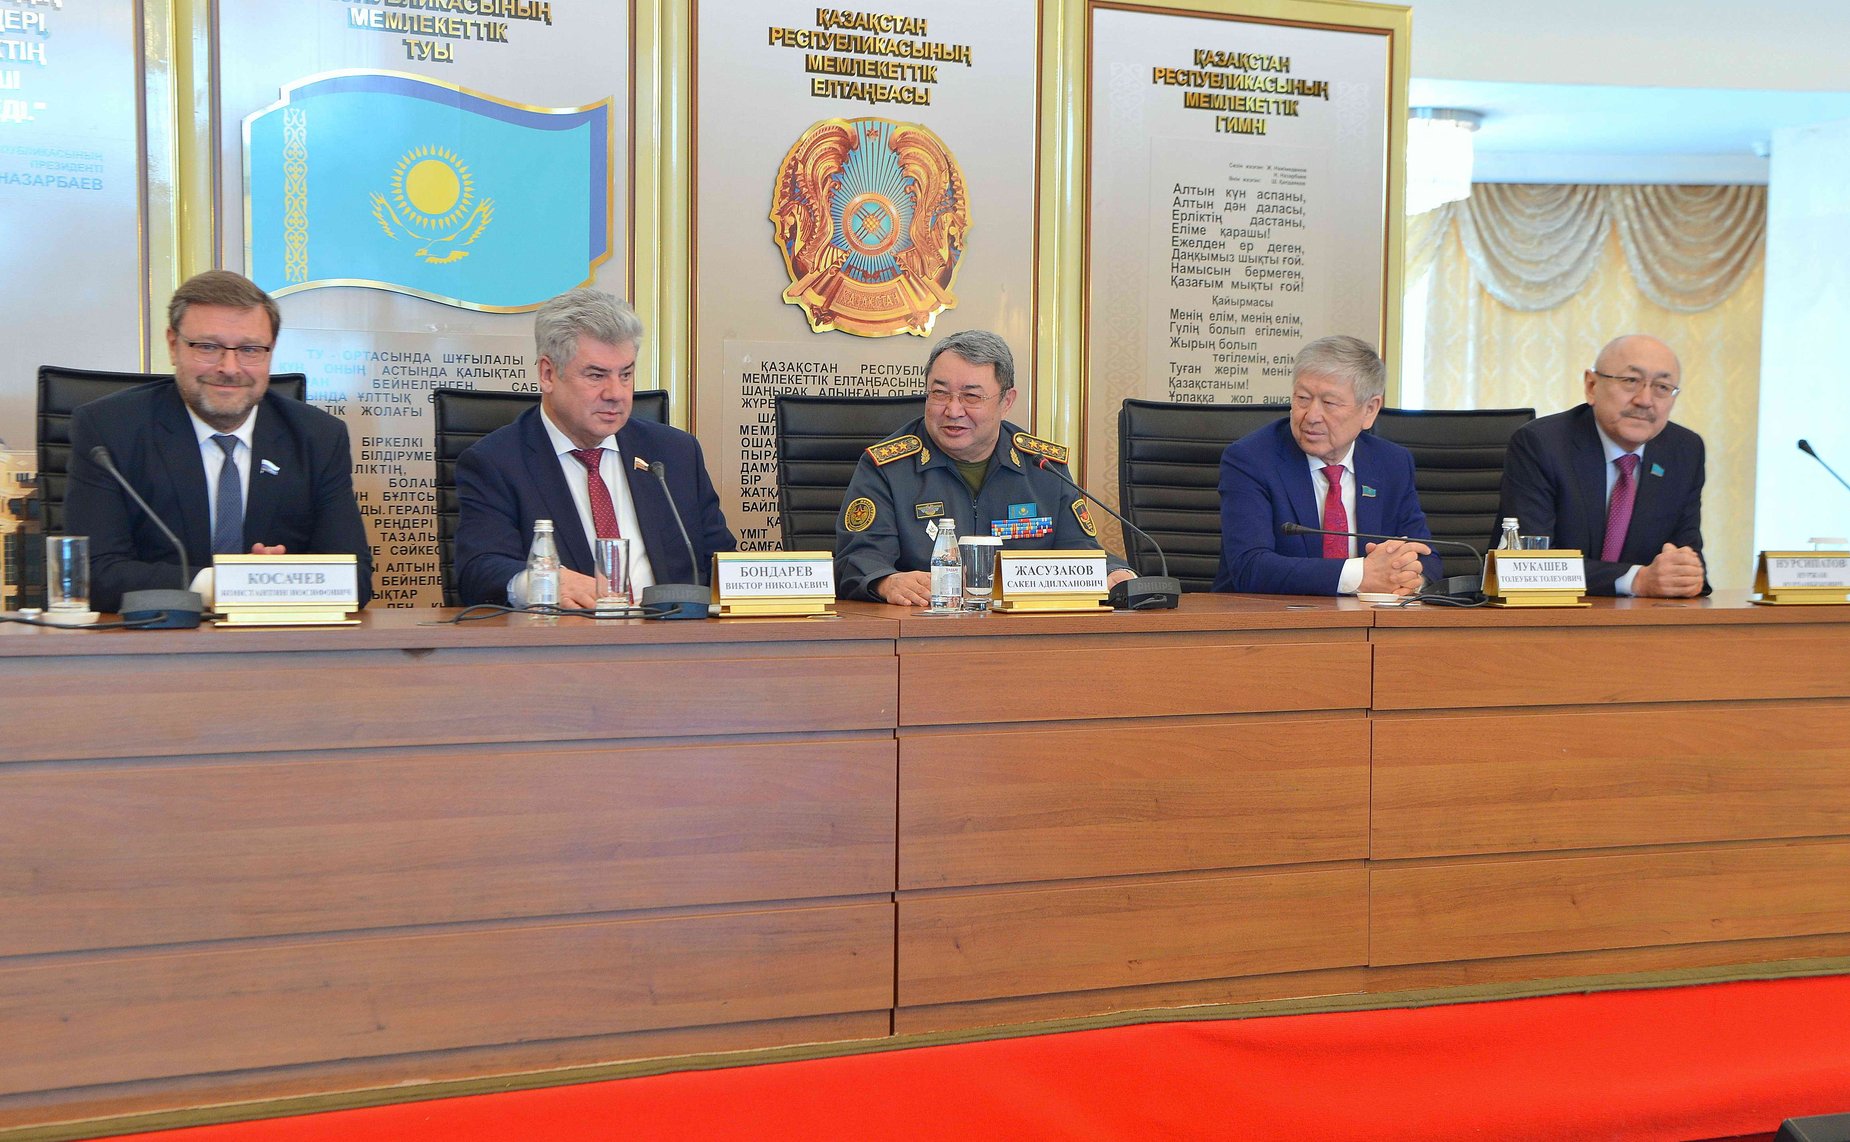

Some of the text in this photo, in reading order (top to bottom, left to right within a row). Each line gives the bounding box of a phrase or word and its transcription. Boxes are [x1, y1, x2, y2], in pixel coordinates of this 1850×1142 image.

[348, 7, 509, 43] МЕМЛЕКЕТТІК
[816, 7, 928, 37] ҚАЗАҚСТАН
[402, 38, 454, 63] ТУЫ
[768, 26, 973, 67] РЕСПУБЛИКАСЫНЫҢ
[804, 53, 938, 84] МЕМЛЕКЕТТІК
[1193, 49, 1291, 73] ҚАЗАҚСТАН
[811, 77, 931, 106] ЕЛТАҢБАСЫ
[1152, 67, 1330, 101] РЕСПУБЛИКАСЫНЫҢ
[1184, 91, 1299, 117] МЕМЛЕКЕТТІК
[1216, 115, 1267, 136] ГИМНІ
[0, 172, 103, 190] НАЗАРБАЕВ
[1173, 183, 1306, 203] Алтын күн аспаны,
[1173, 196, 1306, 216] Алтын дән даласы,
[1172, 209, 1306, 230] Ерліктің дастаны,
[1172, 222, 1271, 240] Еліме қарашы!
[1171, 235, 1305, 255] Ежелден ер деген,
[1171, 248, 1235, 263] Даңқымыз
[1238, 254, 1279, 266] шықты
[1171, 262, 1304, 280] Намысын бермеген,
[1171, 275, 1304, 292] Қазағым мықты ғой!
[1212, 295, 1274, 308] Қайырмасы
[1170, 308, 1303, 326] Менің елім, менің елім,
[1169, 321, 1303, 338] Гүлің болып егілемін,
[1169, 336, 1257, 351] Жырың болып
[343, 350, 431, 364] ОРТАСЫНДА
[443, 354, 523, 365] ШҰҒЫЛАЛЫ
[1213, 352, 1269, 365] төгілемін,
[324, 363, 366, 376] ОНЫҢ
[382, 366, 447, 378] АСТЫНДА
[457, 368, 526, 380] ҚАЛЫҚТАП
[761, 361, 838, 374] ҚАЗАҚСТАН
[1169, 362, 1202, 376] Туған
[1214, 364, 1249, 377] жерім
[742, 373, 828, 386] МЕМЛЕКЕТТІК
[1169, 377, 1249, 390] Қазақстаным!
[357, 392, 412, 405] ҰЛТТЫҚ
[1231, 394, 1253, 404] жол
[361, 406, 422, 417] ЖОЛАҒЫ
[362, 437, 423, 447] БІРКЕЛКІ
[741, 438, 776, 448] ОША
[741, 475, 762, 485] БІР
[374, 519, 433, 530] РЕҢДЕРІ
[740, 529, 768, 539] ҮМІТ
[386, 563, 435, 572] АЛТЫН
[740, 566, 813, 578] БОНДАРЕВ
[1015, 565, 1094, 576] ЖАСУЗАКОВ
[1513, 561, 1568, 572] МУКАШЕВ
[248, 572, 325, 585] КОСАЧЕВ
[725, 581, 829, 590] ВИКТОР НИКОЛАЕВИЧ
[1007, 579, 1103, 589] САКЕН АДИЛХАНОВИЧ
[1501, 575, 1582, 583] ТОЛЕУБЕК ТОЛЕУОВИЧ
